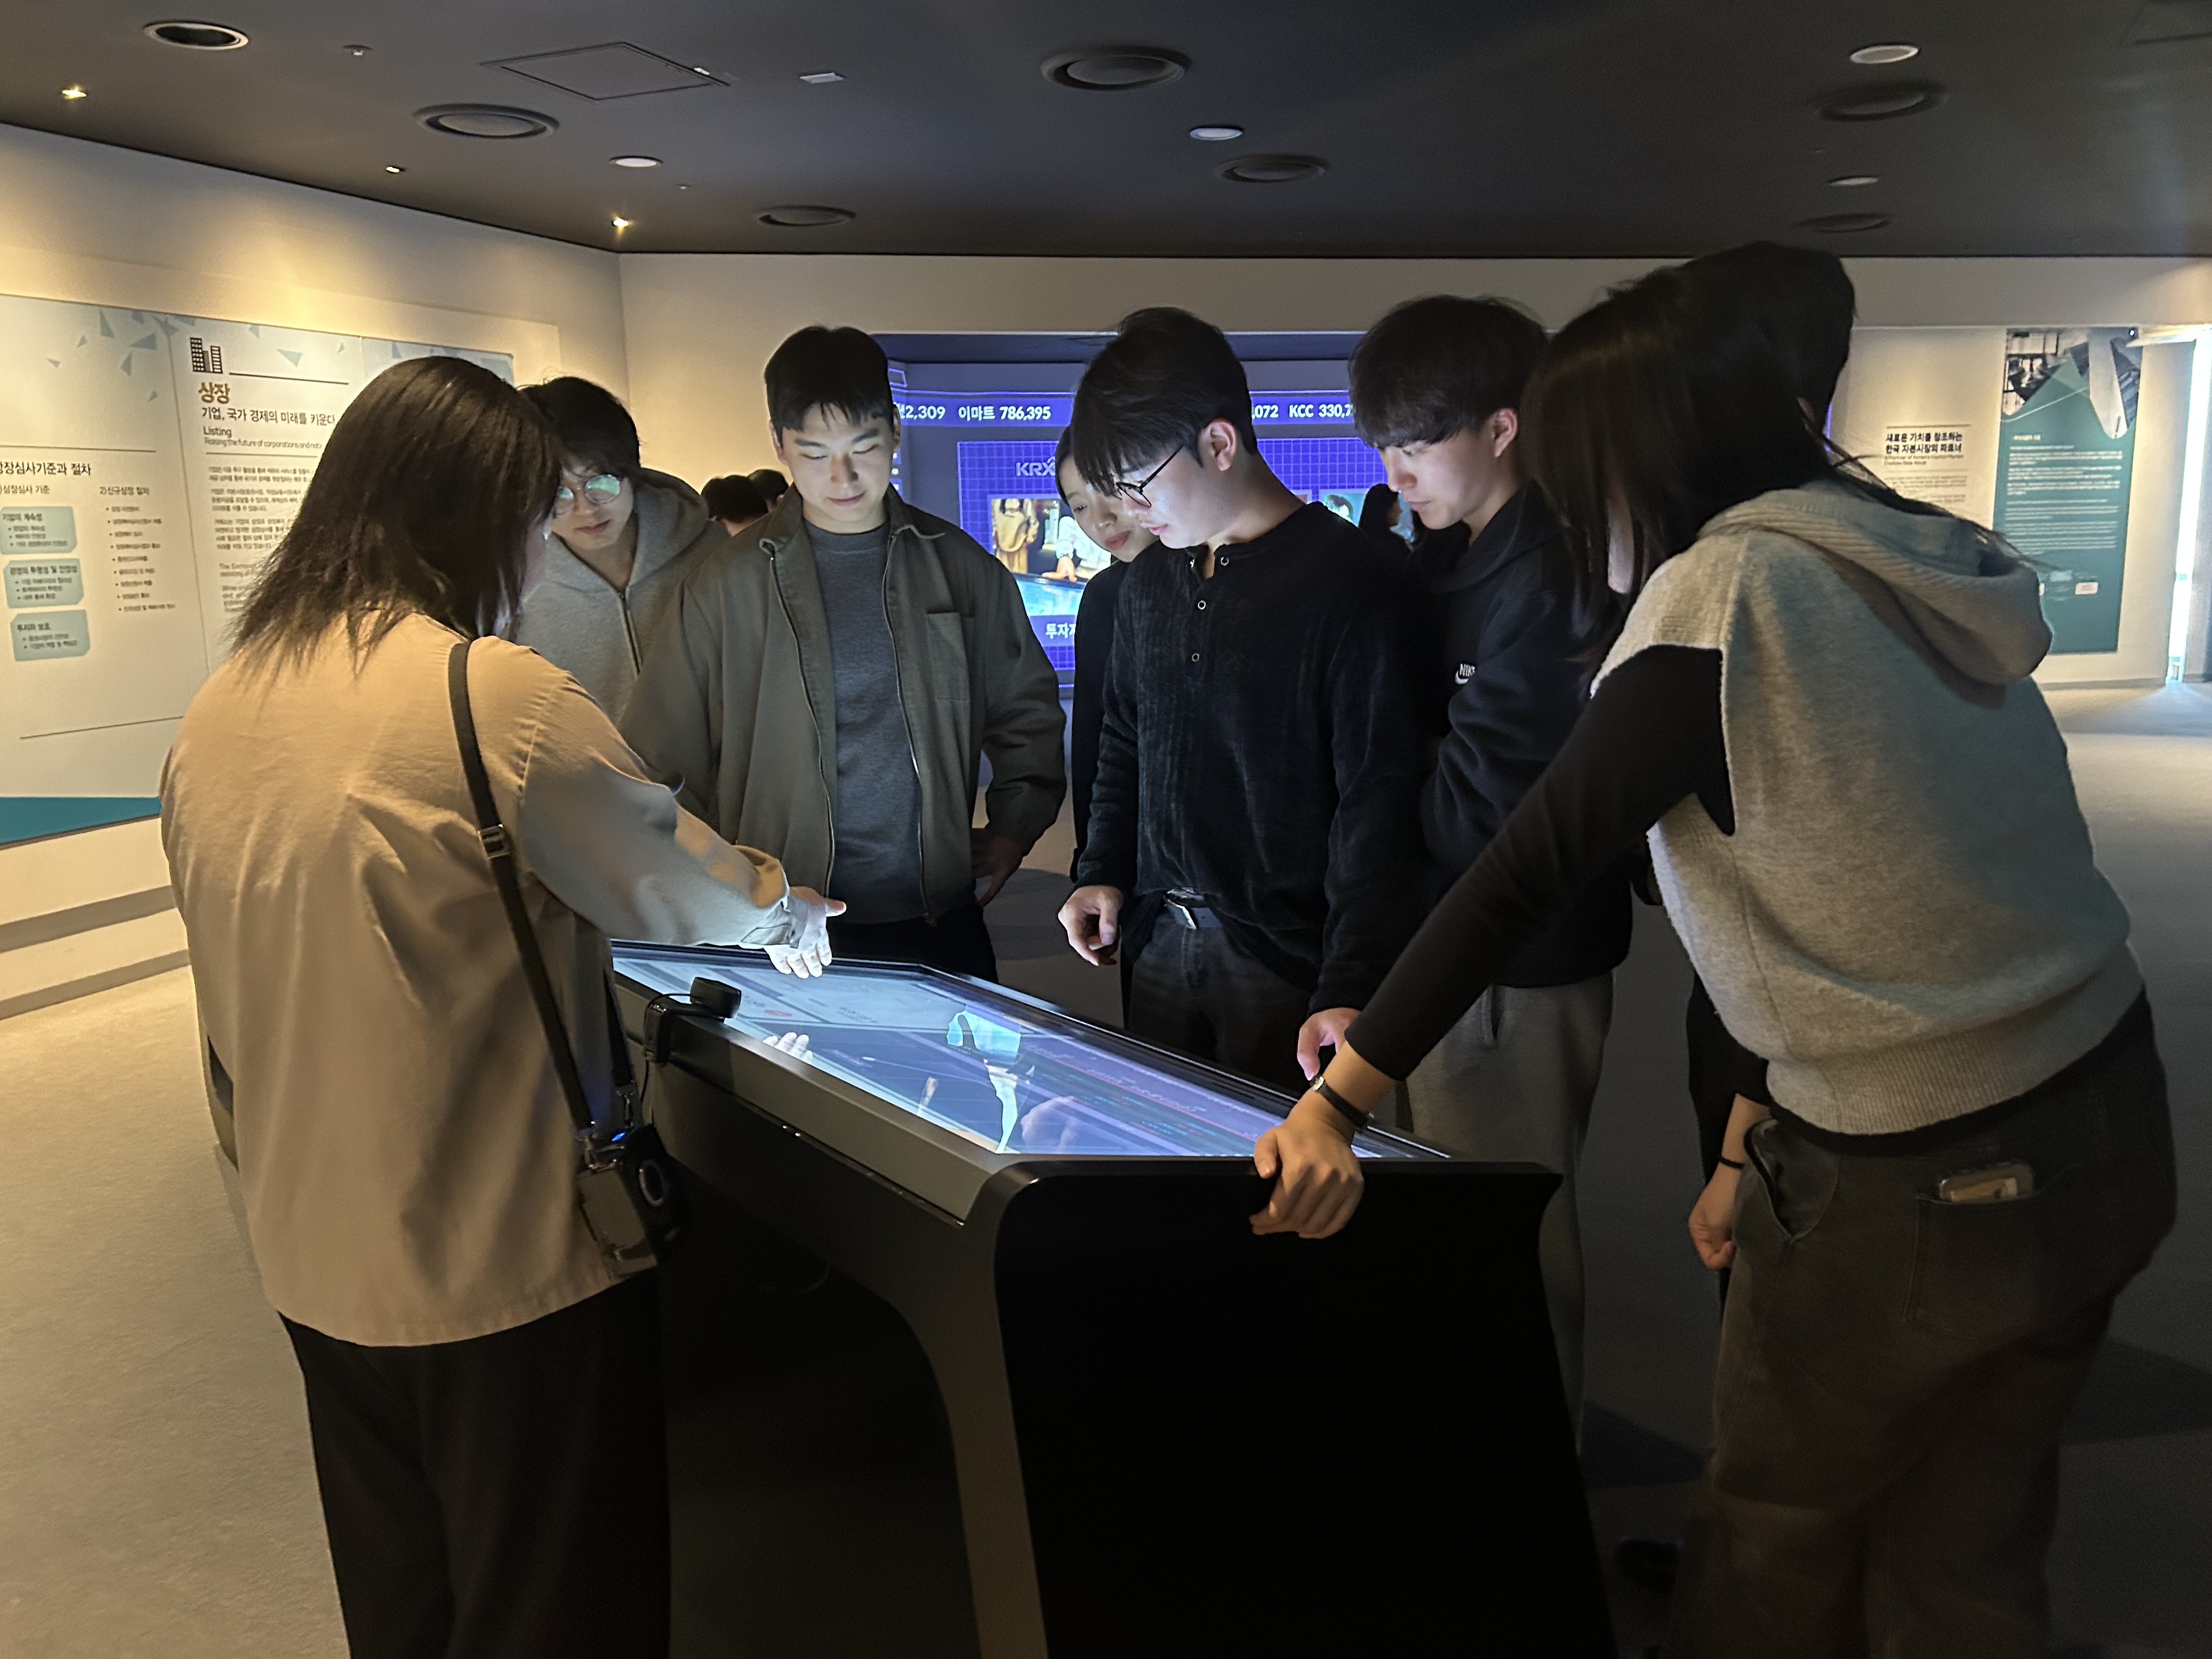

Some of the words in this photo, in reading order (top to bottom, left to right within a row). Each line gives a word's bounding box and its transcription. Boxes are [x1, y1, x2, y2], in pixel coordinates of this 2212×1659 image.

[199, 382, 230, 404] 상장
[202, 407, 224, 420] 기업,
[227, 408, 247, 421] 국가
[250, 410, 278, 424] 경제의
[281, 411, 307, 425] 미래를
[311, 413, 335, 426] 키운다
[958, 405, 995, 421] 이마트
[999, 406, 1051, 420] 786,395
[1251, 405, 1279, 419] ,072
[1289, 404, 1314, 417] KCC
[1318, 404, 1353, 418] 330,7
[204, 426, 232, 438] Listing
[1886, 432, 1908, 442] 새로운
[1910, 432, 1931, 442] 가치를
[1886, 444, 1899, 454] 한국
[71, 462, 91, 476] 절차
[1016, 462, 1056, 476] KRX
[36, 485, 50, 494] 기준
